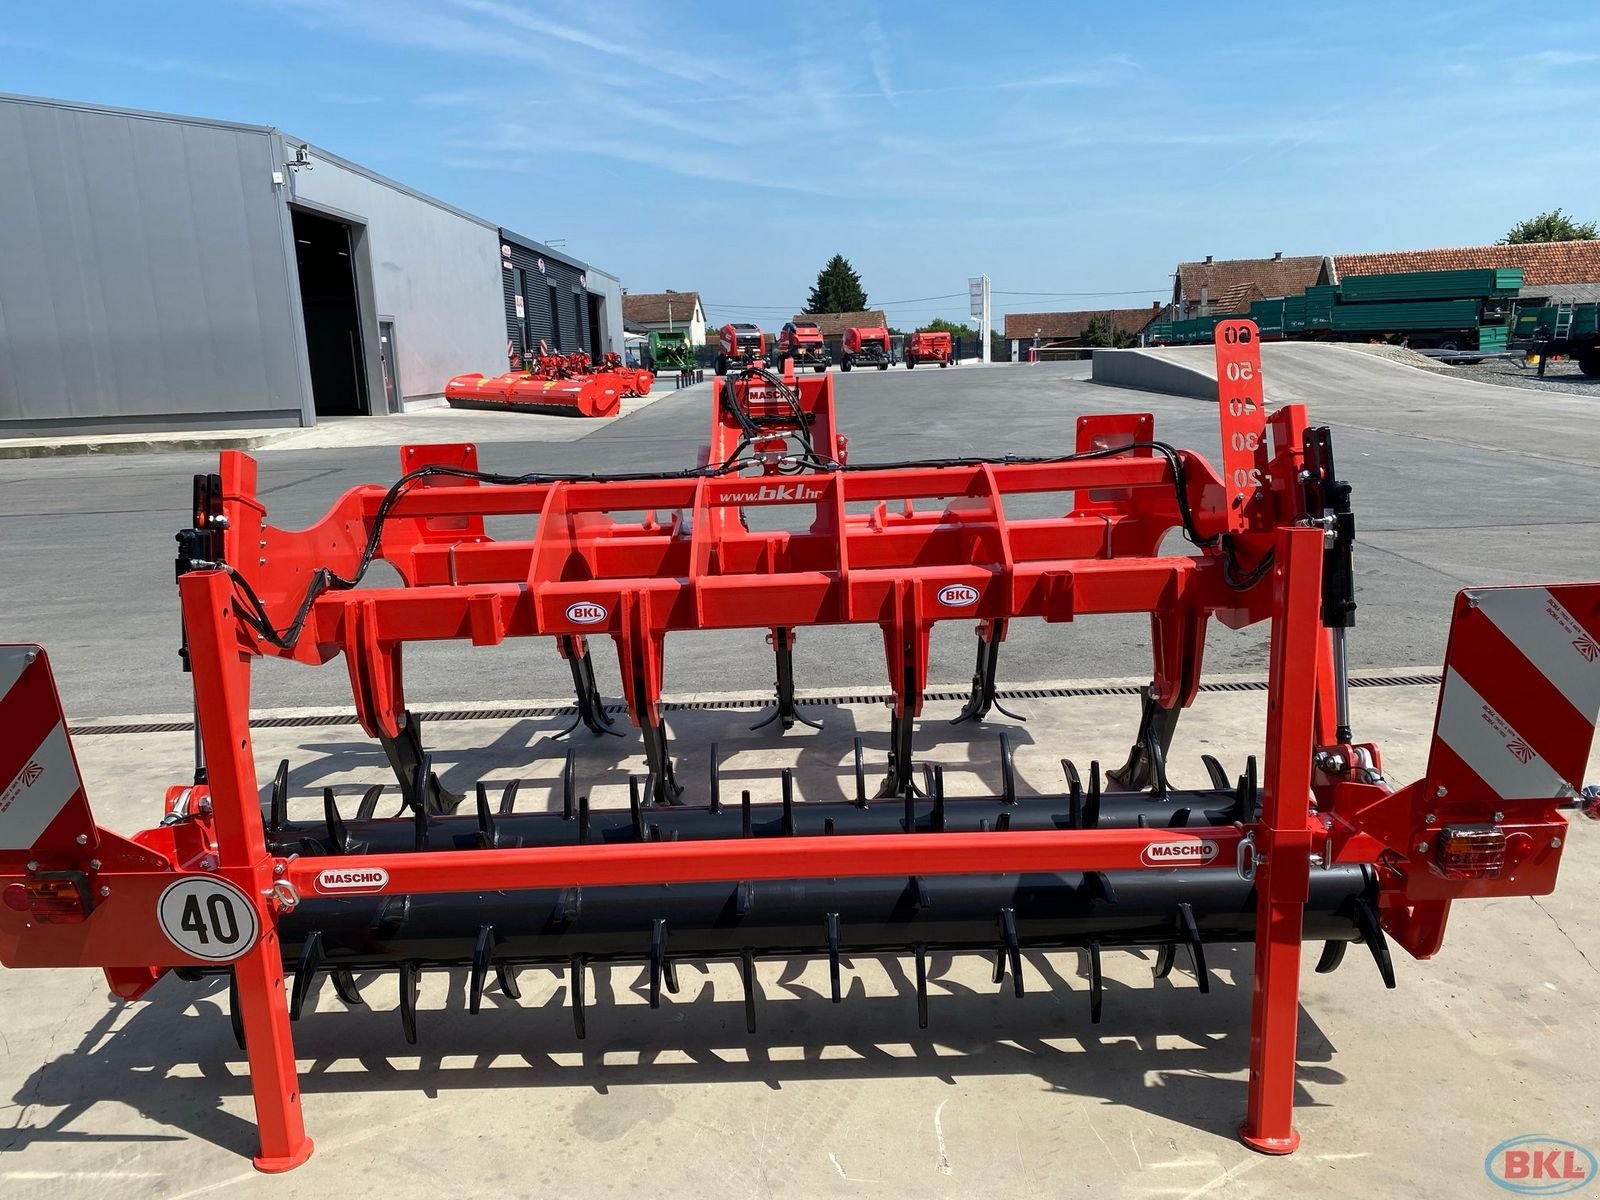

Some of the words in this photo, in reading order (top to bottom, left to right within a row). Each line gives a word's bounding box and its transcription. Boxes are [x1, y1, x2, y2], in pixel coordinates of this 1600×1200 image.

[720, 484, 823, 502] www.bkl.hr
[946, 590, 974, 601] BKL
[574, 608, 602, 618] BKL
[1152, 845, 1213, 857] MASCHIO
[324, 873, 383, 884] MASCHIO
[181, 893, 240, 945] 40
